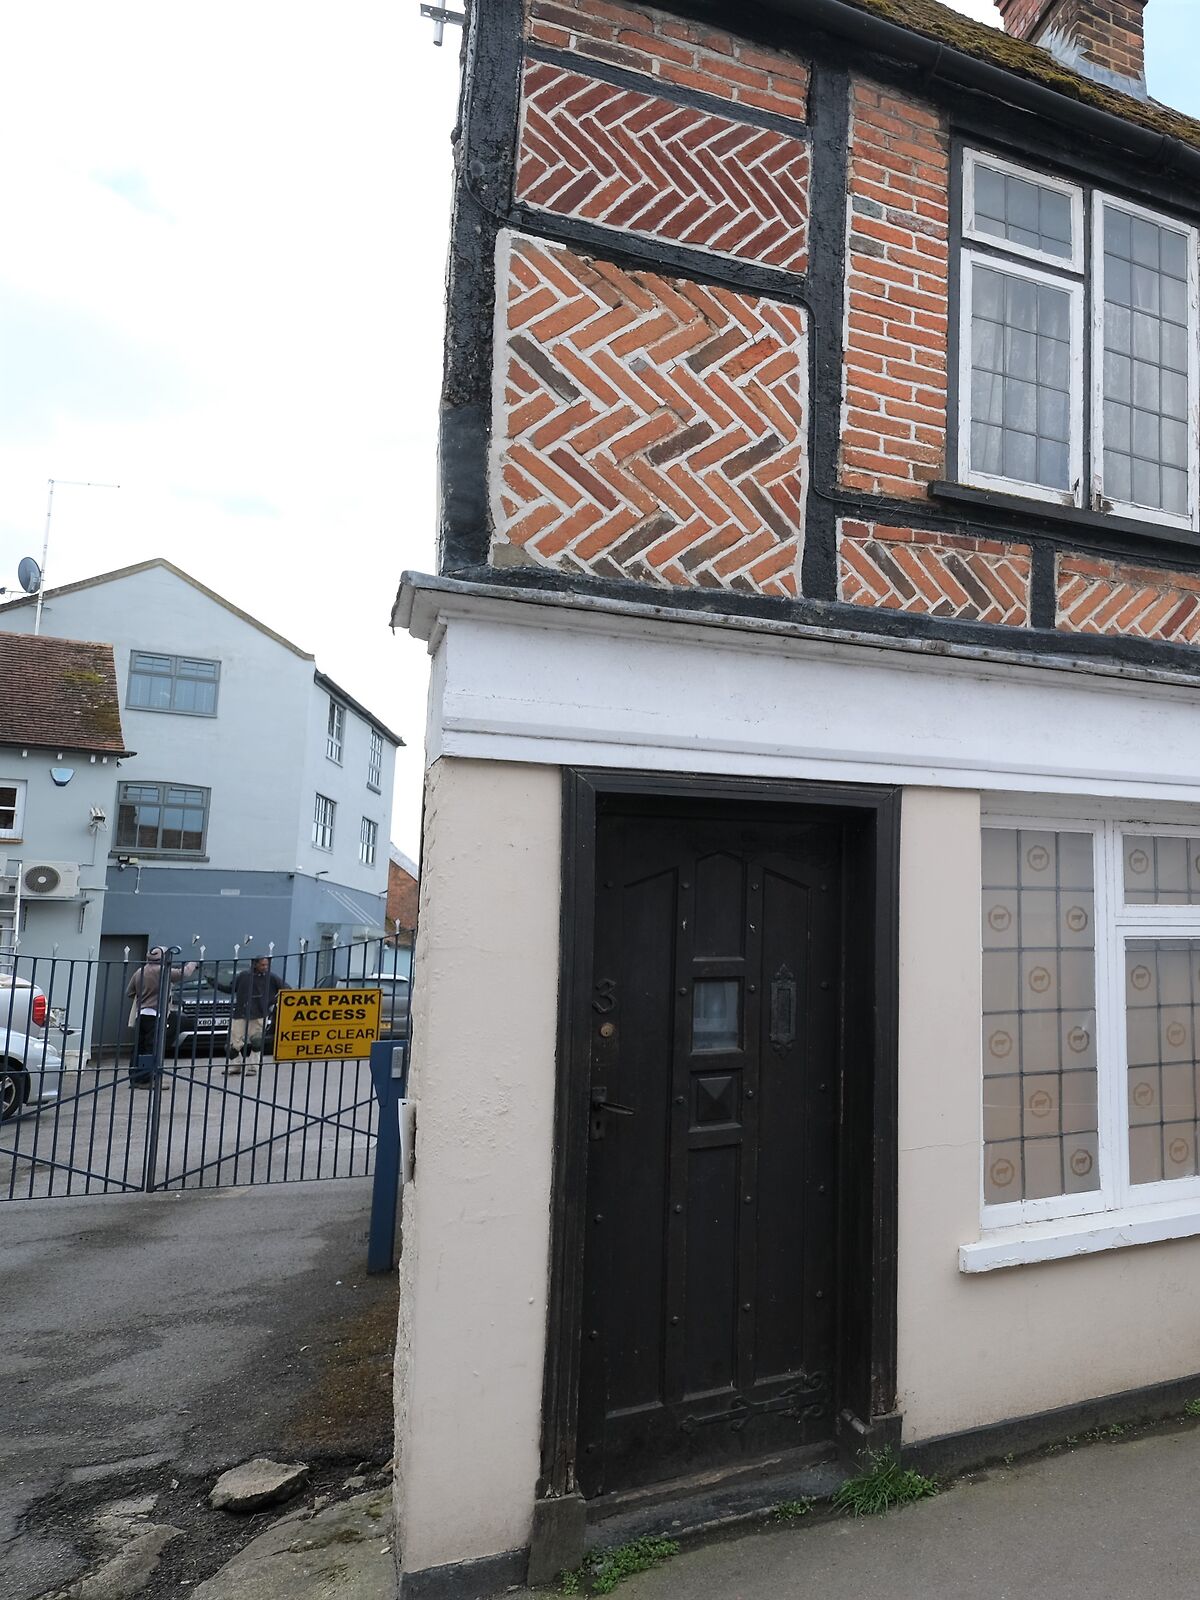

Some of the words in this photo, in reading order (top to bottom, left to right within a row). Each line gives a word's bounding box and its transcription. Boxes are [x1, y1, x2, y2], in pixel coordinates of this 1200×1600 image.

[283, 995, 322, 1007] CAR
[328, 994, 376, 1006] PARK
[592, 978, 617, 1014] 3
[292, 1008, 367, 1022] ACCESS
[280, 1030, 321, 1042] KEEP
[326, 1028, 375, 1040] CLEAR
[296, 1043, 354, 1056] PLEASE
